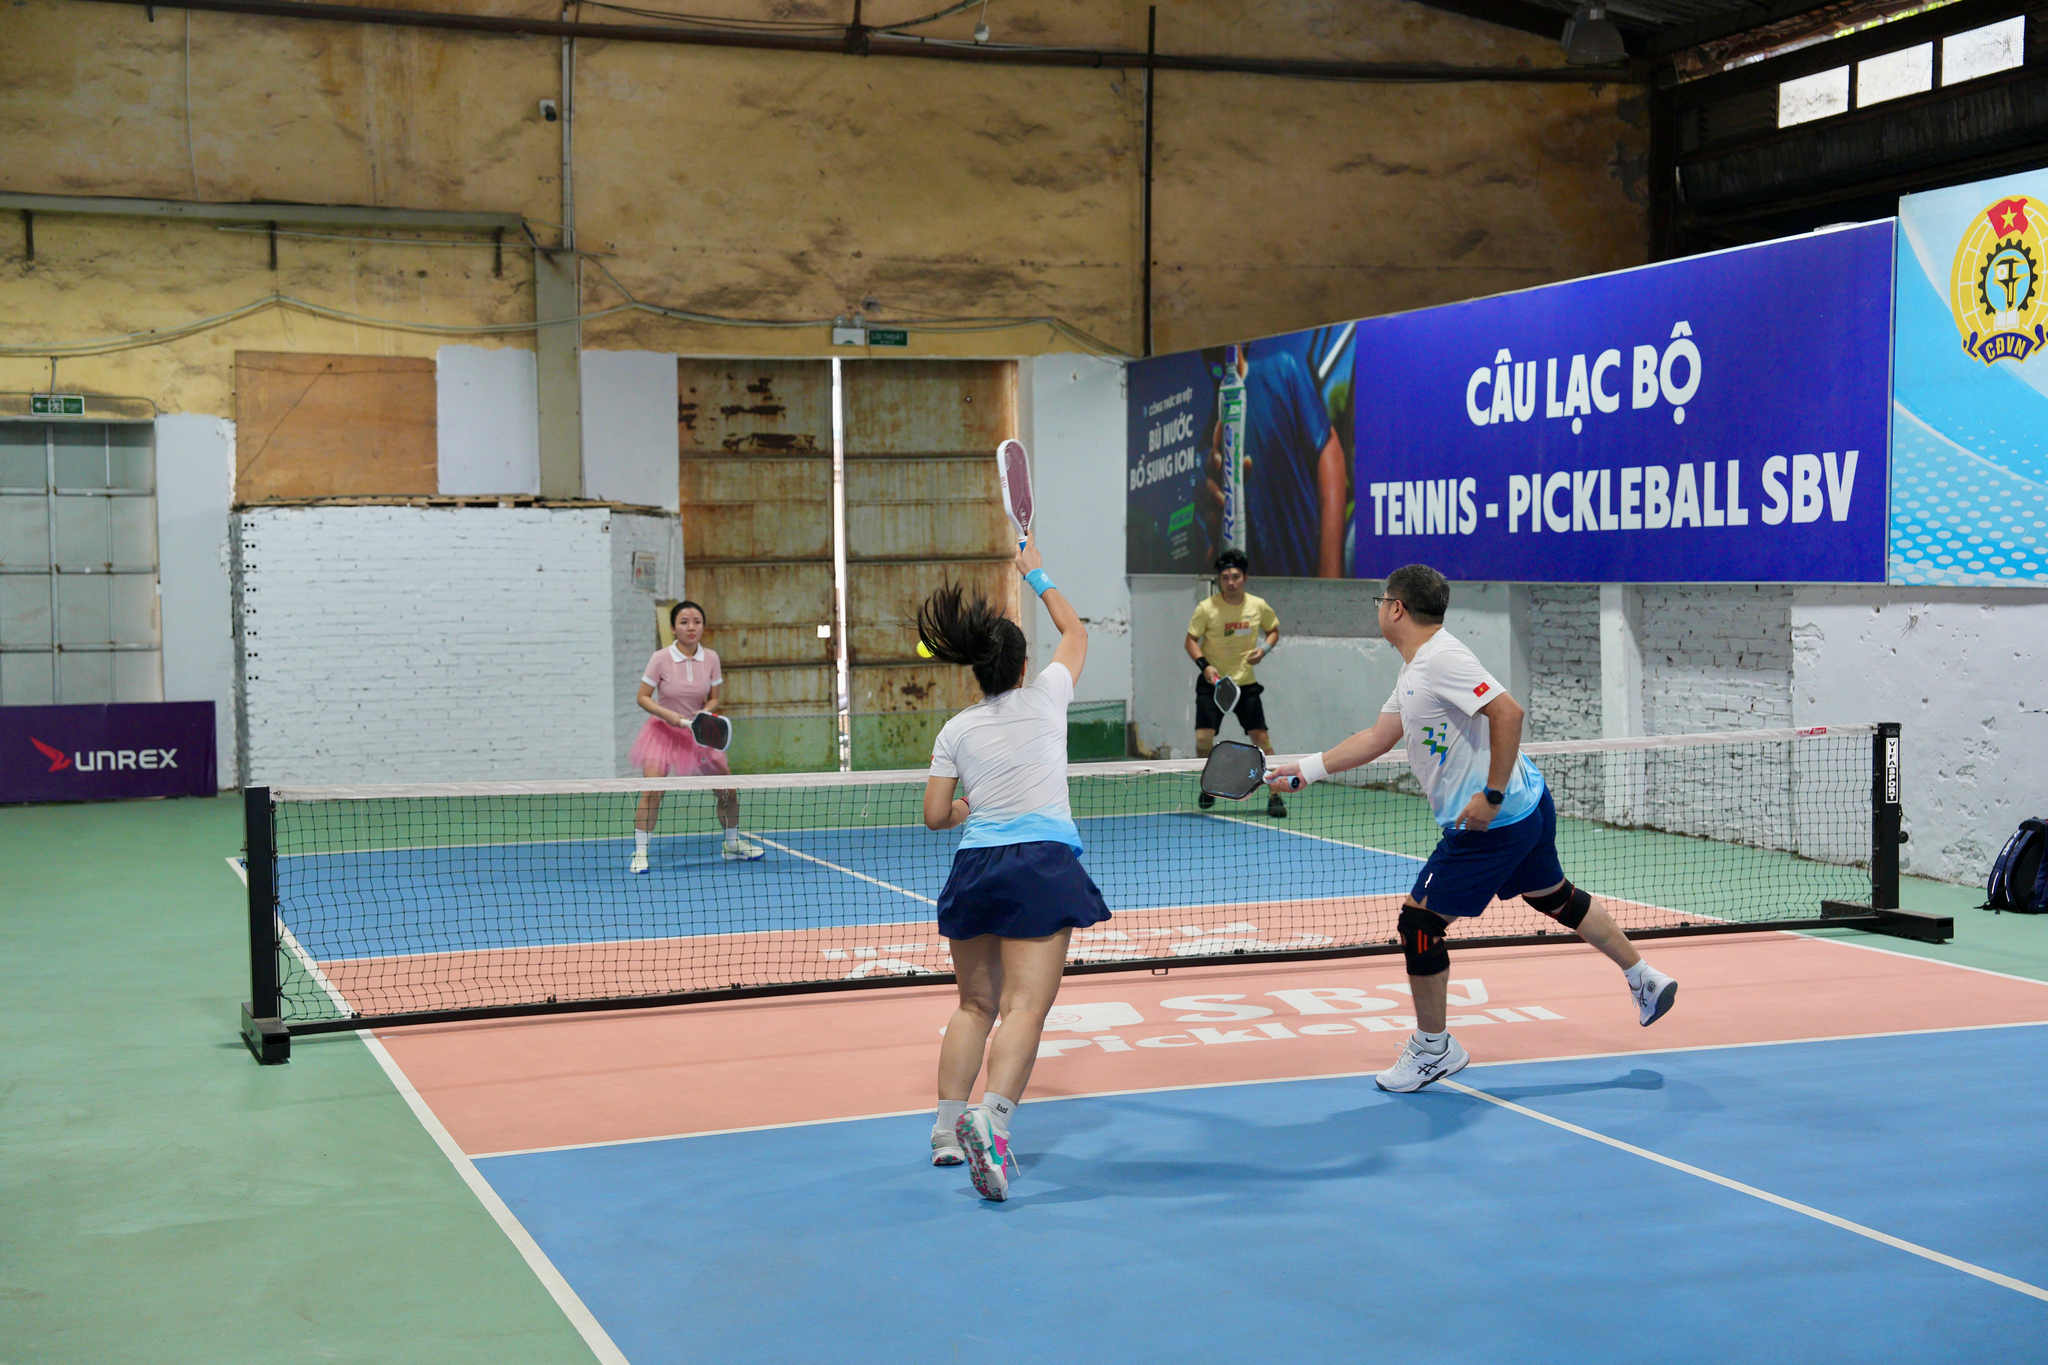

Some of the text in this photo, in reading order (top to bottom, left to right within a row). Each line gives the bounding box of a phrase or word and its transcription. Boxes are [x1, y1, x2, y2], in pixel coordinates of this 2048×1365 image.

[1985, 335, 2027, 360] CĐVN
[1466, 320, 1702, 435] CÂU LẠC BỘ
[1148, 411, 1194, 453] BÙ NƯỚC
[1129, 445, 1195, 491] BỔ SUNG ION
[1370, 476, 1478, 536] TENNIS
[1508, 459, 1749, 534] PICKLEBALL
[1761, 449, 1860, 526] SBV
[75, 748, 178, 772] UNREX
